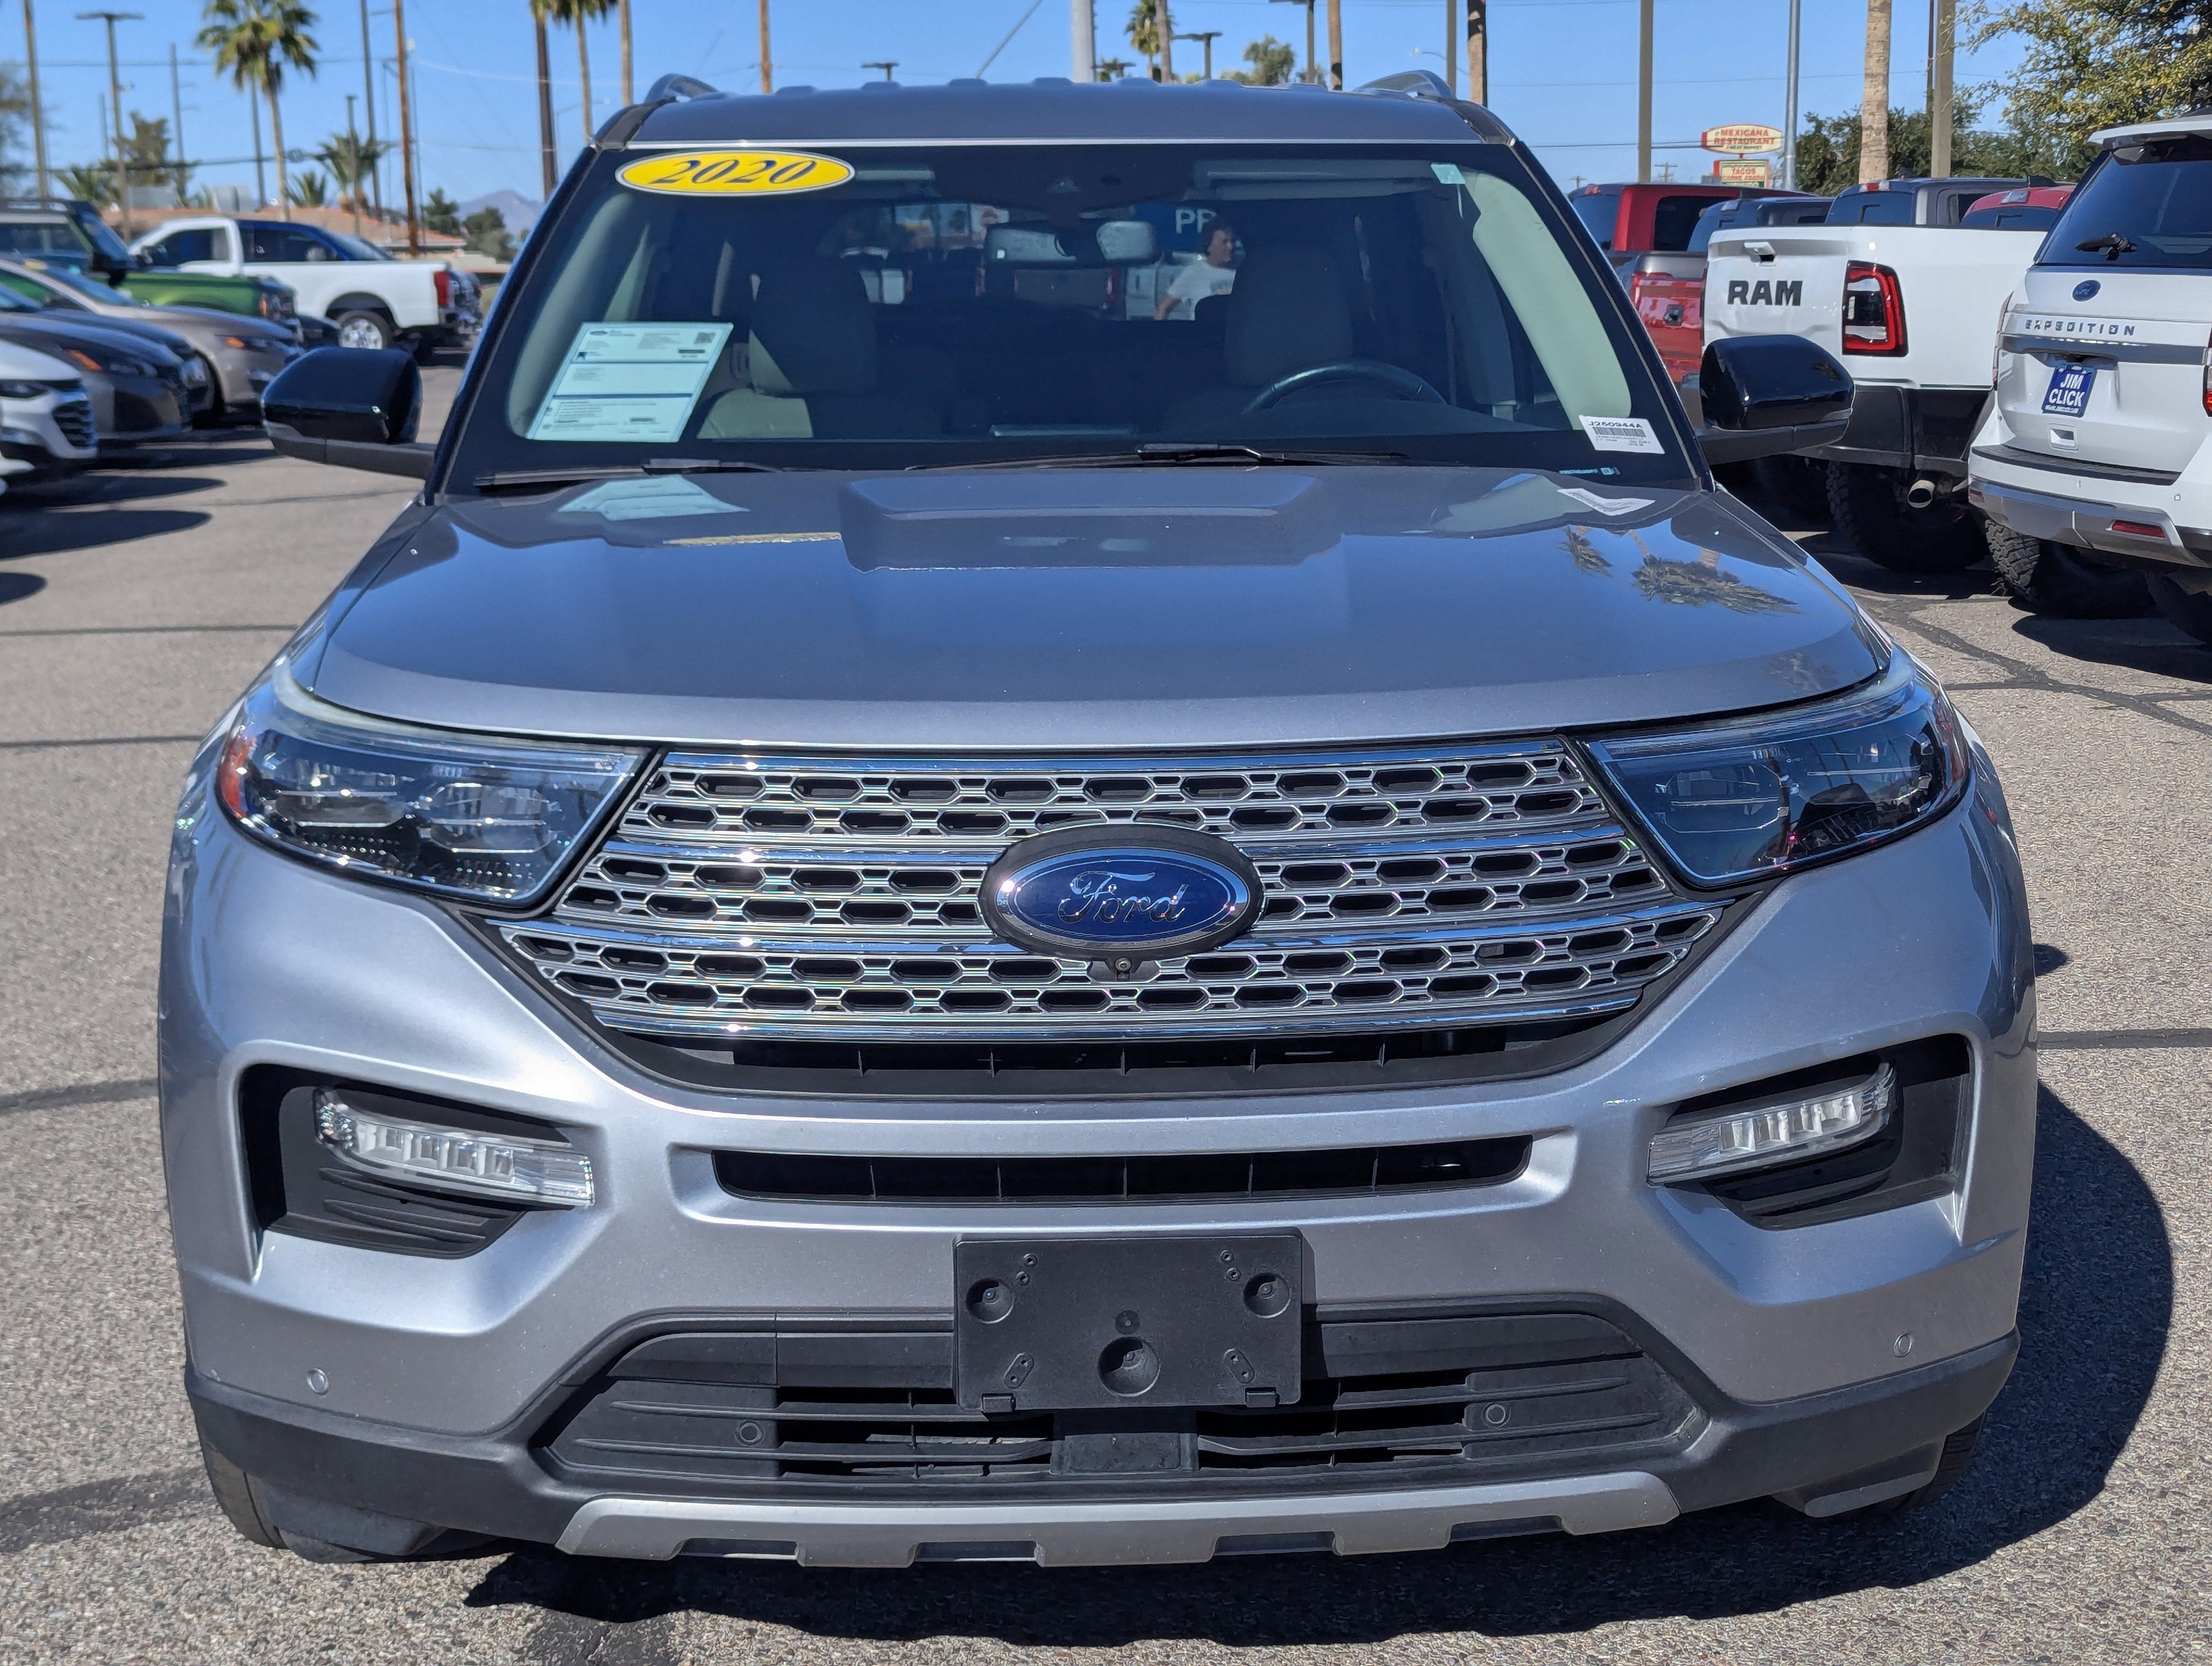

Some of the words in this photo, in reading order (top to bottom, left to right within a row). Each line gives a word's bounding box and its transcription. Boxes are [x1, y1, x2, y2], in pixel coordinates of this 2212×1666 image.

[1714, 137, 1776, 145] RESTAURANT
[647, 159, 818, 184] 2020
[1727, 280, 1803, 306] RAM
[2025, 319, 2136, 336] EXPEDITION
[2060, 373, 2084, 389] JIM
[2048, 388, 2086, 407] CLICK
[1058, 870, 1190, 923] Ford
